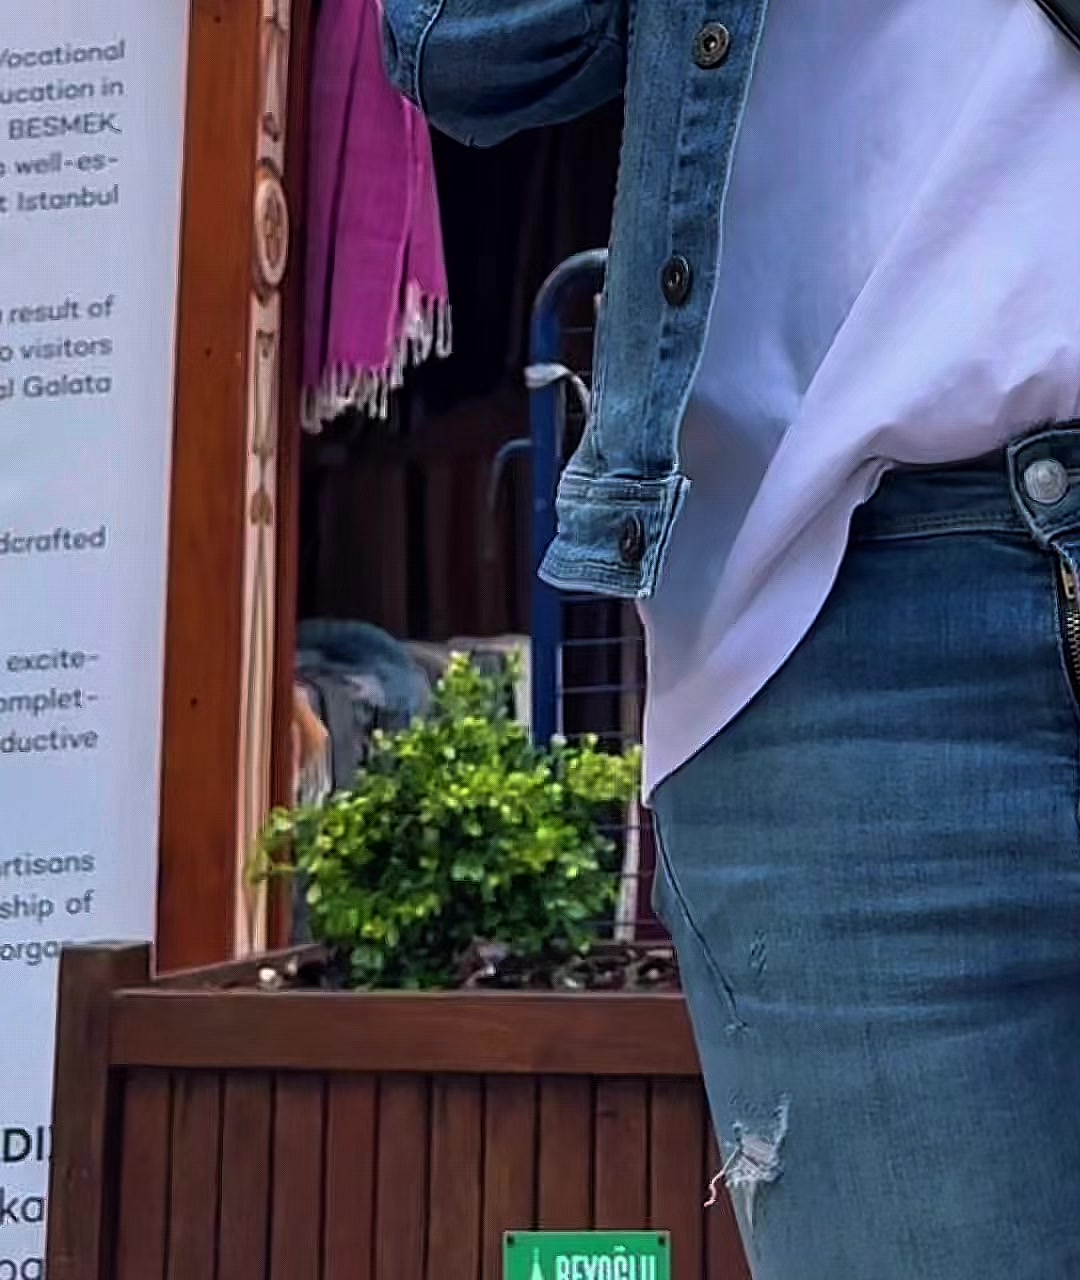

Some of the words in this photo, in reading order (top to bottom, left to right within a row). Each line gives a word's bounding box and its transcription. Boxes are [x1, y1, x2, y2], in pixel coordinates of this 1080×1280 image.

[101, 76, 124, 97] in
[17, 183, 119, 213] Istanbul
[8, 297, 80, 323] result
[87, 293, 118, 318] of
[20, 338, 113, 360] visitors
[23, 375, 112, 398] Galata
[6, 648, 99, 672] excite-
[0, 853, 95, 876] rtisans
[65, 889, 95, 914] of
